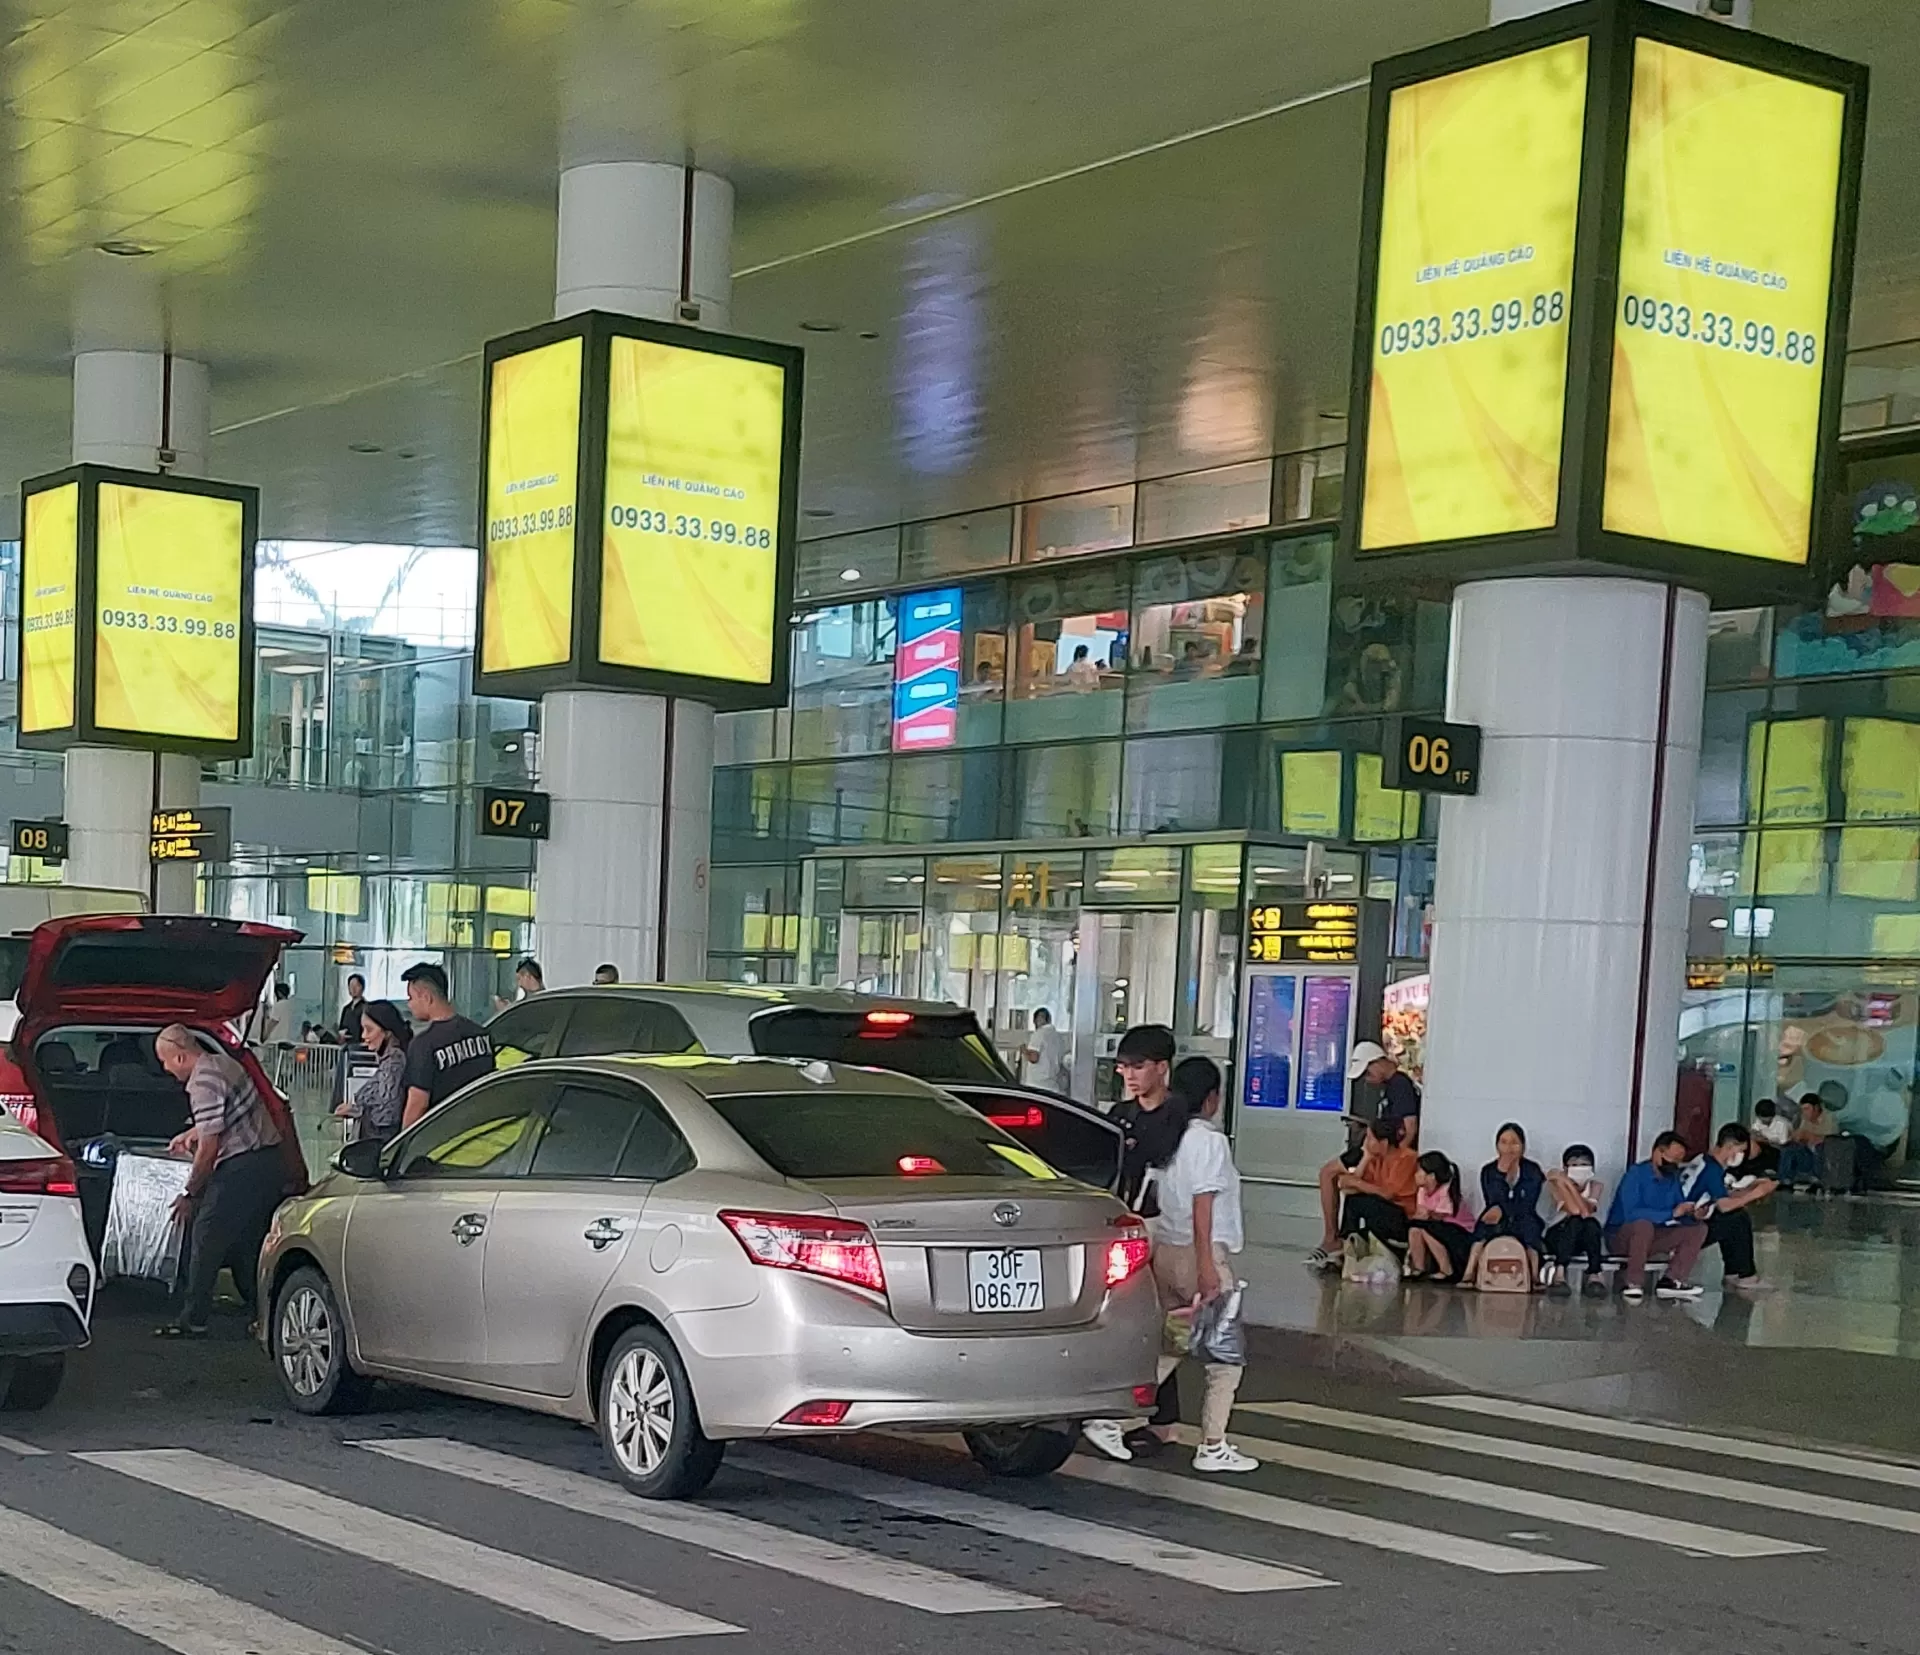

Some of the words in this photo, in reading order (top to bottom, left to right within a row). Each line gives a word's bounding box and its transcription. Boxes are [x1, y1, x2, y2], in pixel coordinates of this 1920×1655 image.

[1381, 291, 1564, 355] 0933.33.99.88
[1624, 295, 1816, 364] 0933.33.99.88
[491, 505, 573, 542] 0933.33.99.88
[611, 505, 770, 549] 0933.33.99.88
[102, 609, 235, 639] 0933.33.99.88
[1408, 735, 1450, 776] 06
[1455, 770, 1471, 785] 1F
[490, 799, 526, 827] 07
[19, 828, 48, 850] 08
[988, 1252, 1024, 1279] 30F
[974, 1281, 1040, 1309] 086.77
